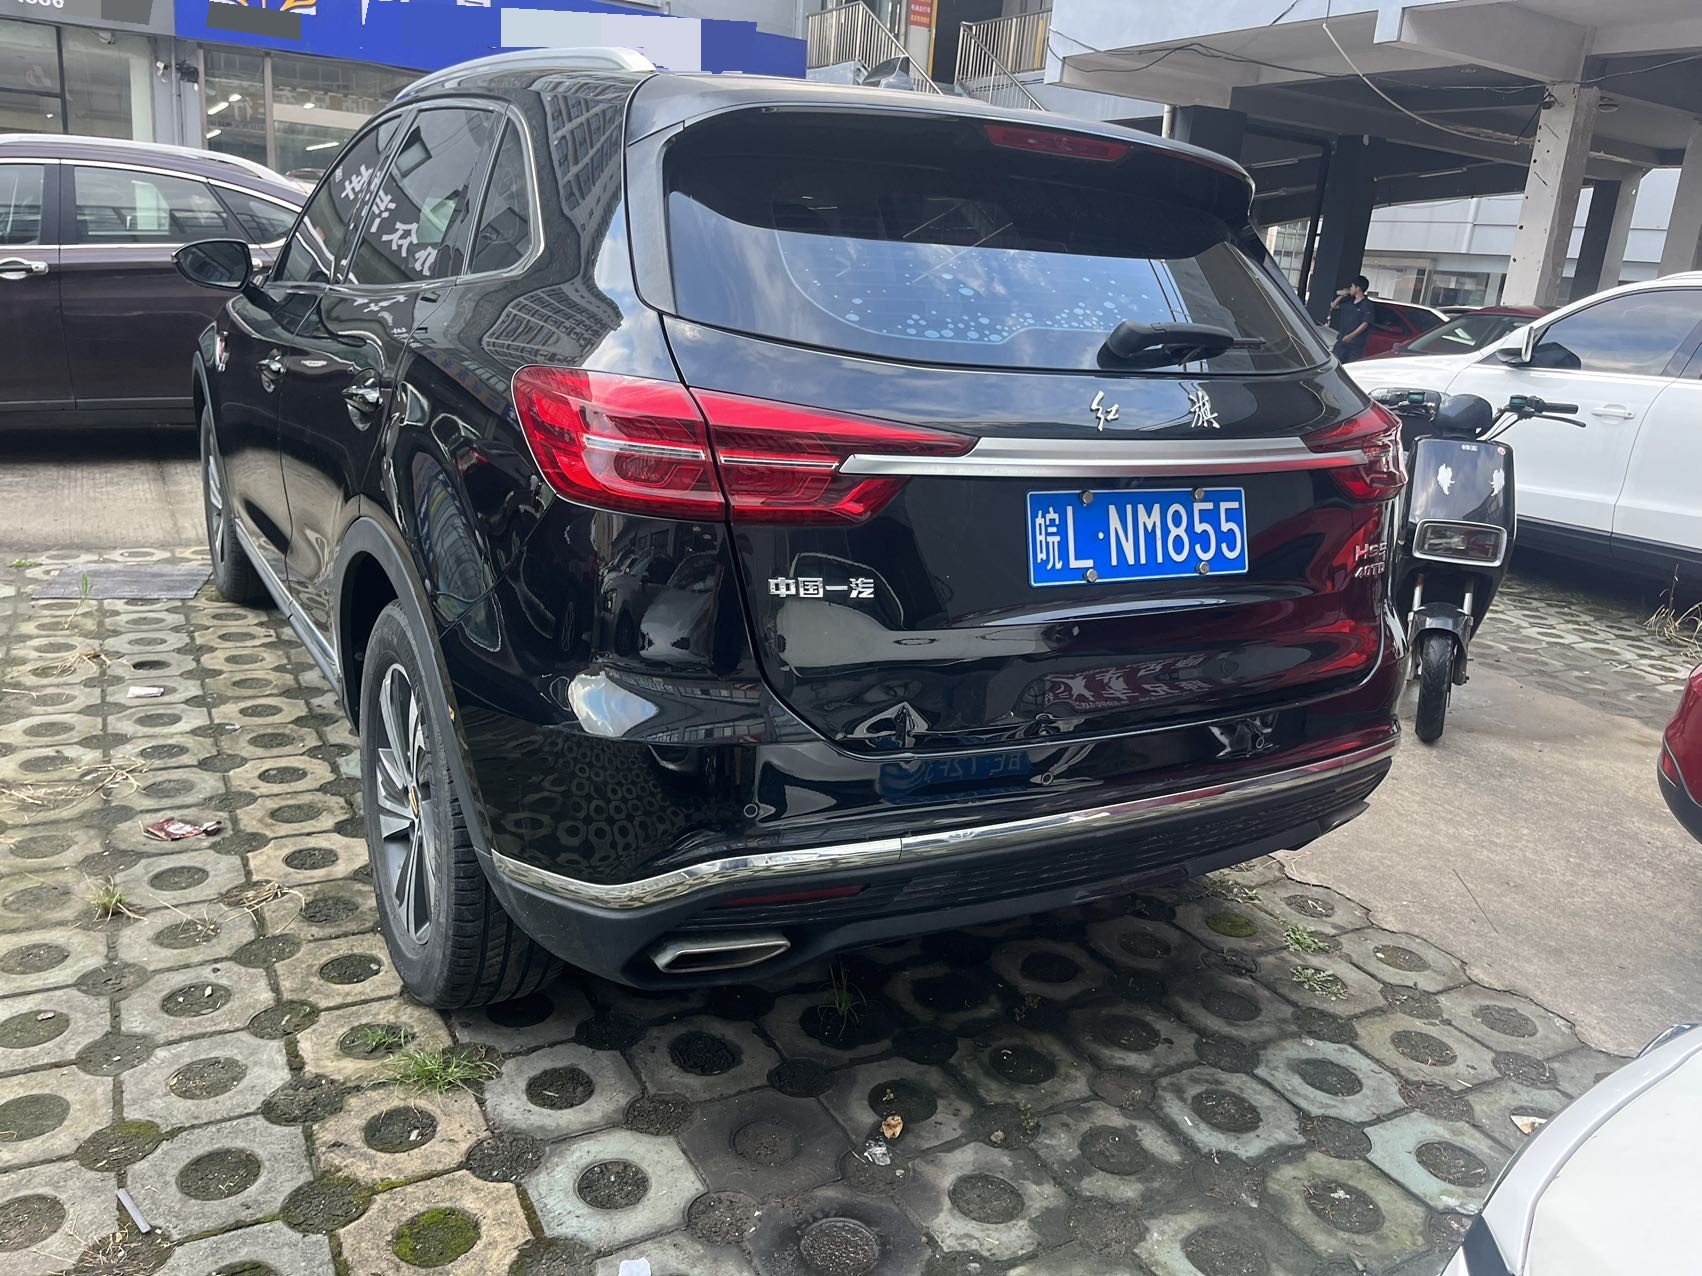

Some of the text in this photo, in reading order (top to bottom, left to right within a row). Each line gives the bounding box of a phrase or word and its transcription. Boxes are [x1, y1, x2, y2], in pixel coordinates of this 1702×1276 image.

[1090, 390, 1221, 432] 红旗
[768, 577, 875, 598] 中国一汽
